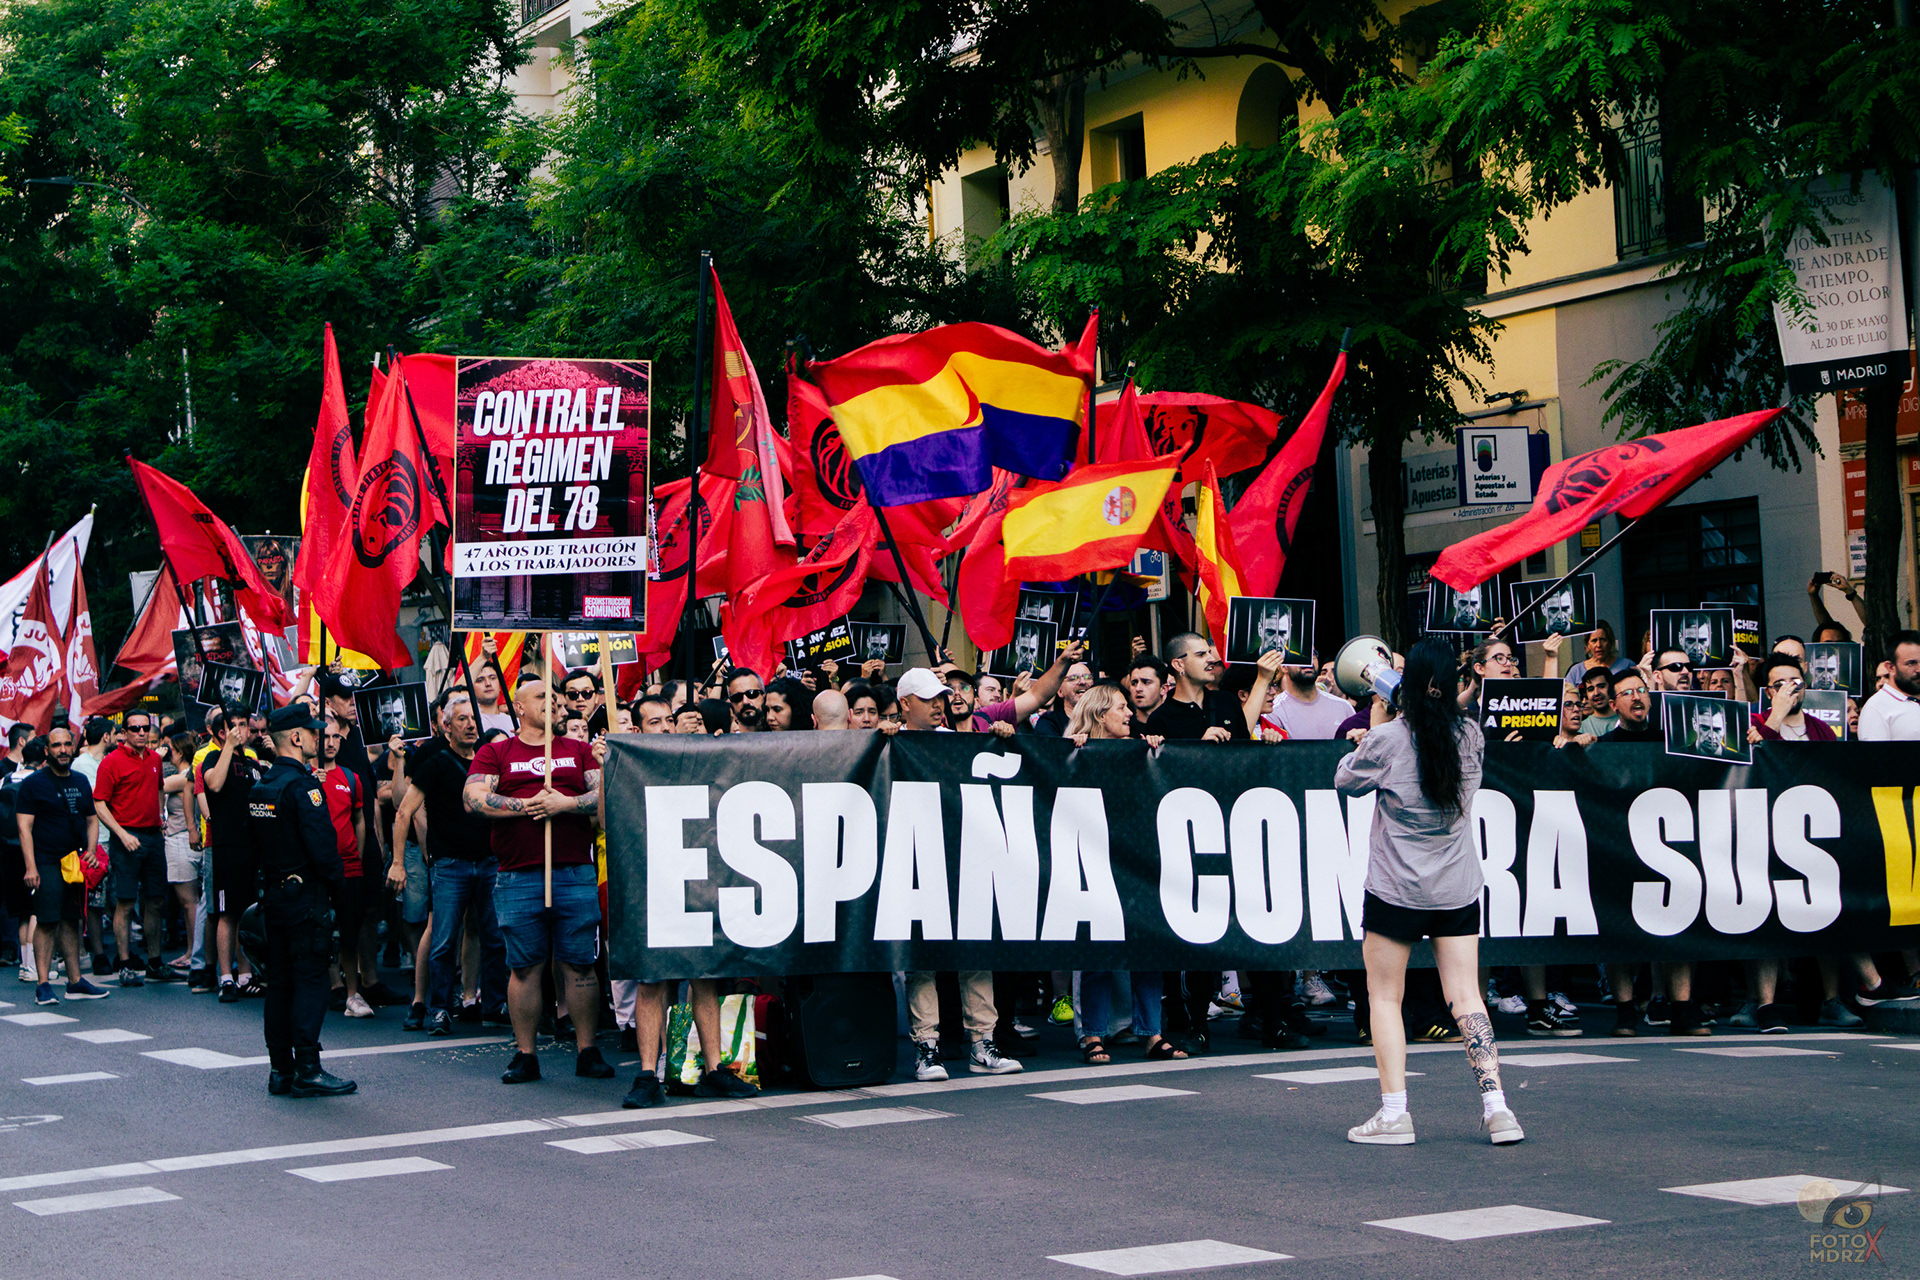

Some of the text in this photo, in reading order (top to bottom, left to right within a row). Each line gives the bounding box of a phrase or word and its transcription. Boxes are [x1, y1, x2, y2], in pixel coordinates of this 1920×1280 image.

[1811, 246, 1889, 270] ANDRADE
[1847, 285, 1891, 304] OLOR
[1826, 321, 1838, 332] 30
[1840, 319, 1855, 331] DE
[1858, 314, 1889, 328] MAYO
[1810, 330, 1888, 350] AL 20 DE JULIO
[1836, 364, 1888, 381] MADRID
[473, 386, 625, 437] CONTRA EL
[486, 431, 612, 484] RÉGIMEN
[1409, 462, 1450, 483] Loterías
[1474, 474, 1501, 482] Loterías
[1475, 482, 1505, 490] Apuestas
[1475, 490, 1498, 498] Estado
[1411, 486, 1457, 508] Apuestas
[503, 486, 600, 533] DEL 78
[464, 539, 637, 558] 47 AÑOS DE TRAICIÓN
[464, 555, 637, 572] A LOS TRABAJADORES
[585, 605, 631, 618] COMUNISTA
[568, 644, 579, 655] A
[1488, 694, 1557, 712] SÁNCHEZ
[1484, 710, 1558, 728] A PRISIÓN
[249, 802, 269, 811] POLICIA
[250, 810, 277, 818] NACIONAL
[643, 750, 1127, 948] ESPAÑA
[1156, 785, 1600, 945] CONRA
[1627, 784, 1843, 937] SUS
